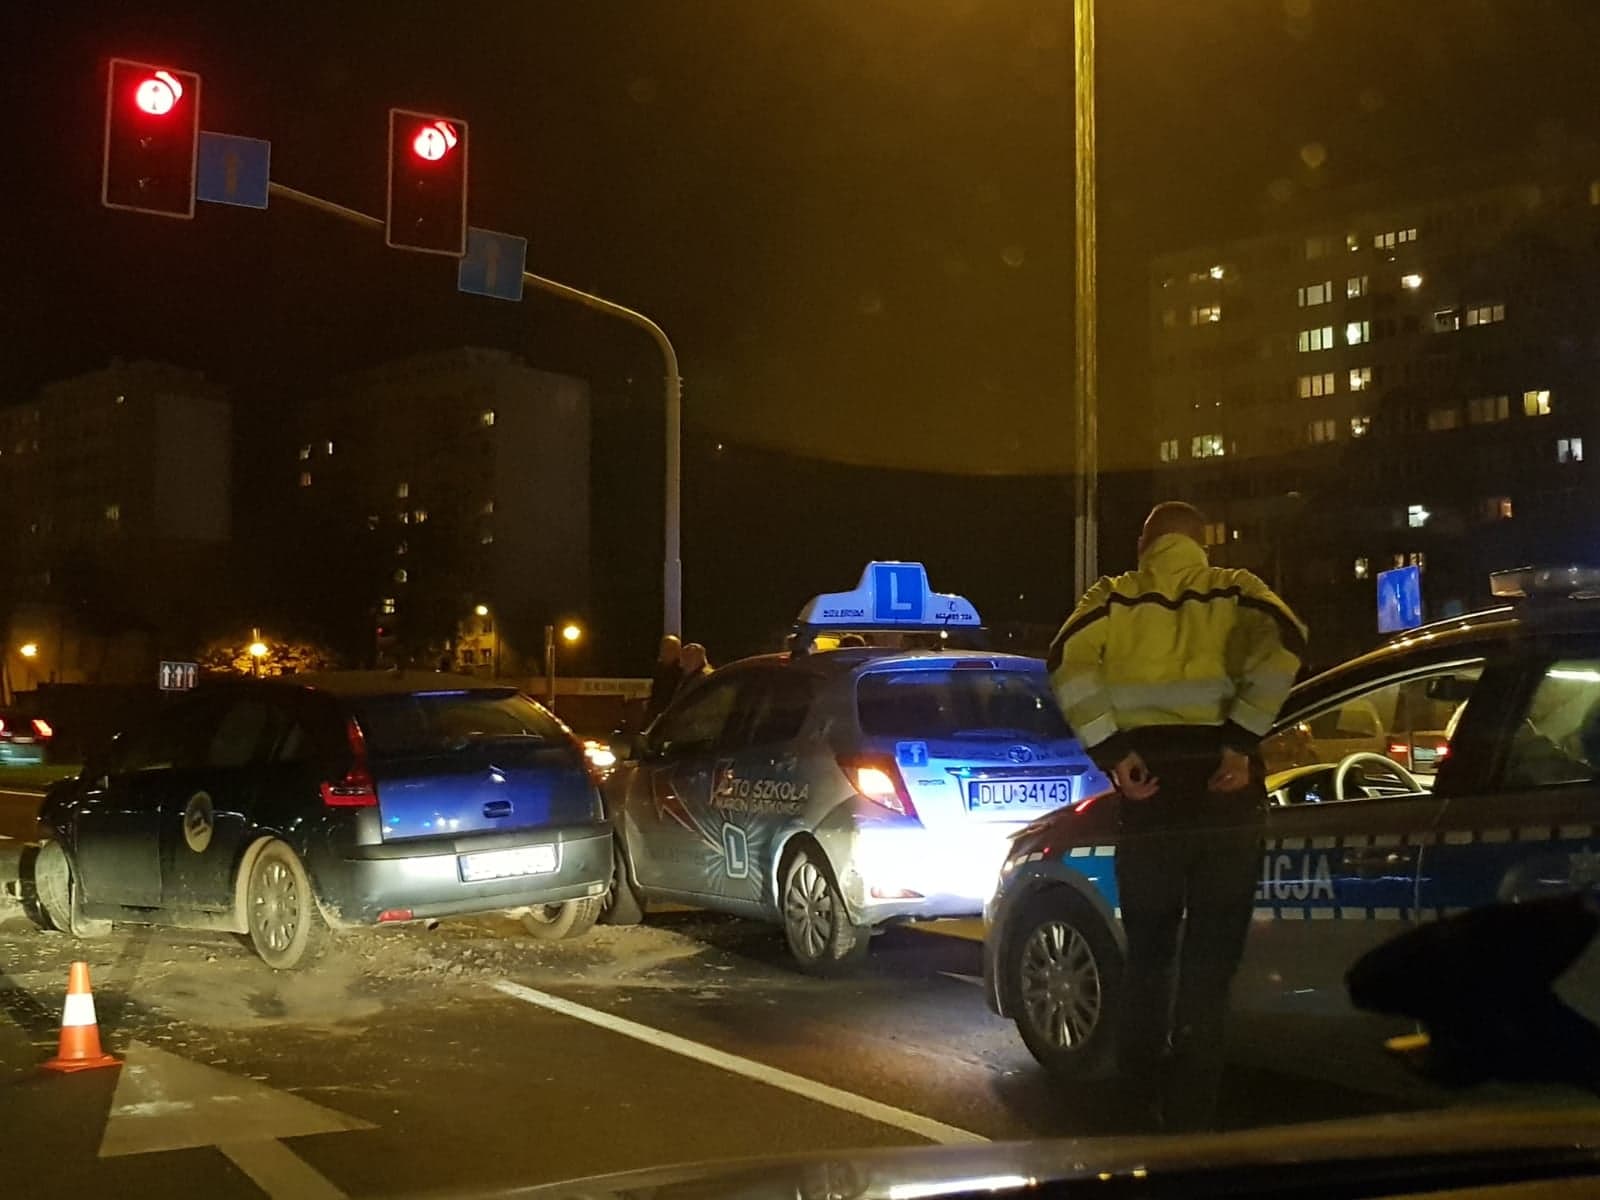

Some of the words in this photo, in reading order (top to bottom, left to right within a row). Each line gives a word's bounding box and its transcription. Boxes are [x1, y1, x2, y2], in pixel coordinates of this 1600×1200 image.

[889, 572, 912, 610] L
[981, 784, 1013, 805] DLU
[1019, 783, 1068, 805] 34143
[729, 835, 744, 869] L
